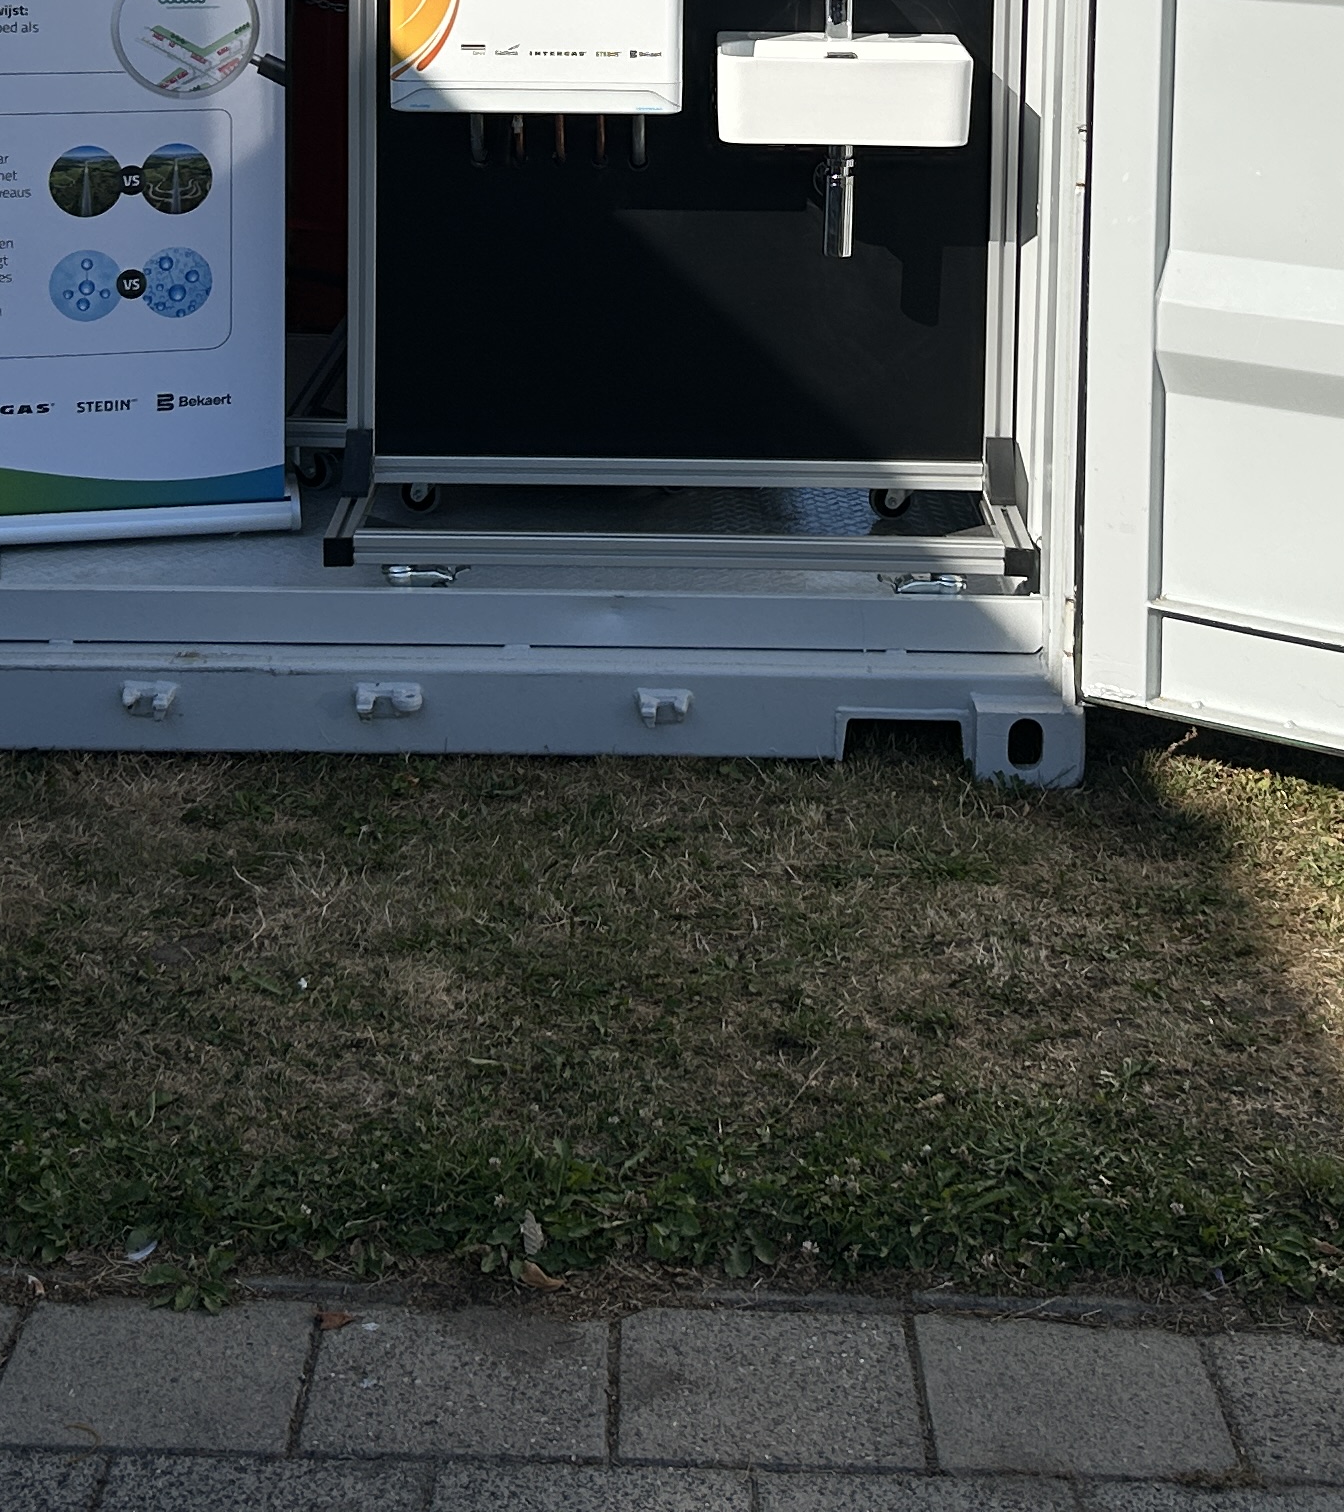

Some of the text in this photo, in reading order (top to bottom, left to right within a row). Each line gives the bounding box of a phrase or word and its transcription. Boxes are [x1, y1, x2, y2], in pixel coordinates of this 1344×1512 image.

[21, 20, 39, 33] als
[76, 399, 131, 413] STEDIN
[178, 394, 232, 407] Bekaert
